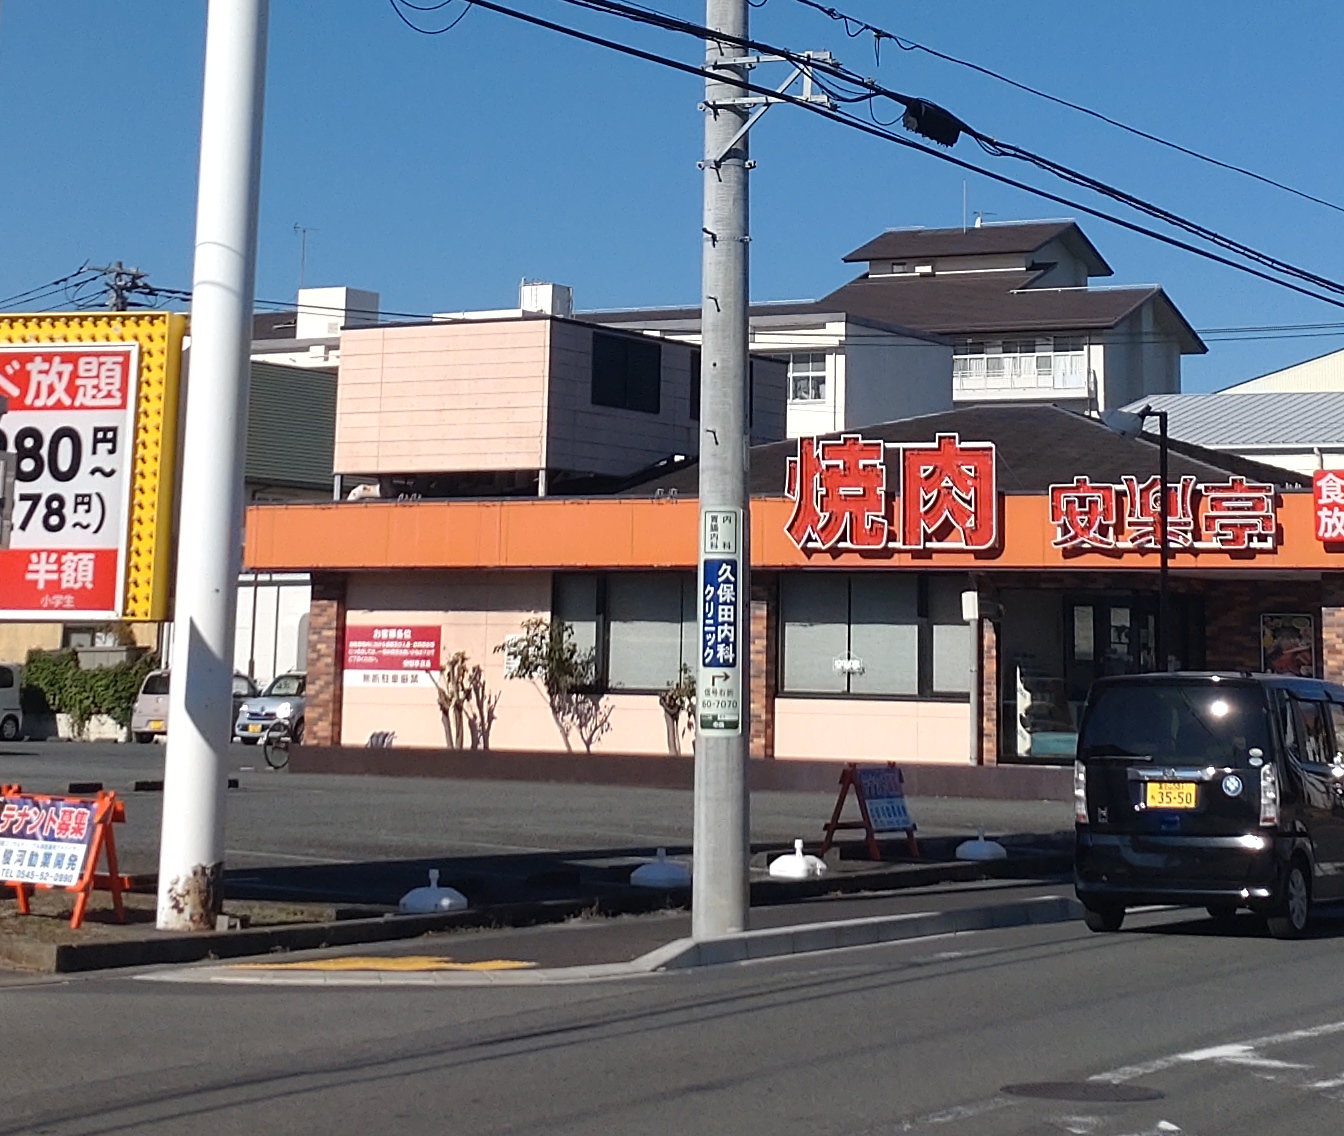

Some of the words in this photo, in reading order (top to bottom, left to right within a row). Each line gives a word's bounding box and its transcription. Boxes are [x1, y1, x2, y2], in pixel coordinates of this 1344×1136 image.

[784, 432, 996, 550] 焼肉
[1048, 475, 1276, 549] 安楽亭
[25, 551, 96, 591] 半額
[40, 593, 75, 608] 小学生
[703, 584, 717, 664] クリニック
[716, 562, 736, 664] 久保田内科
[1, 868, 14, 879] TEL
